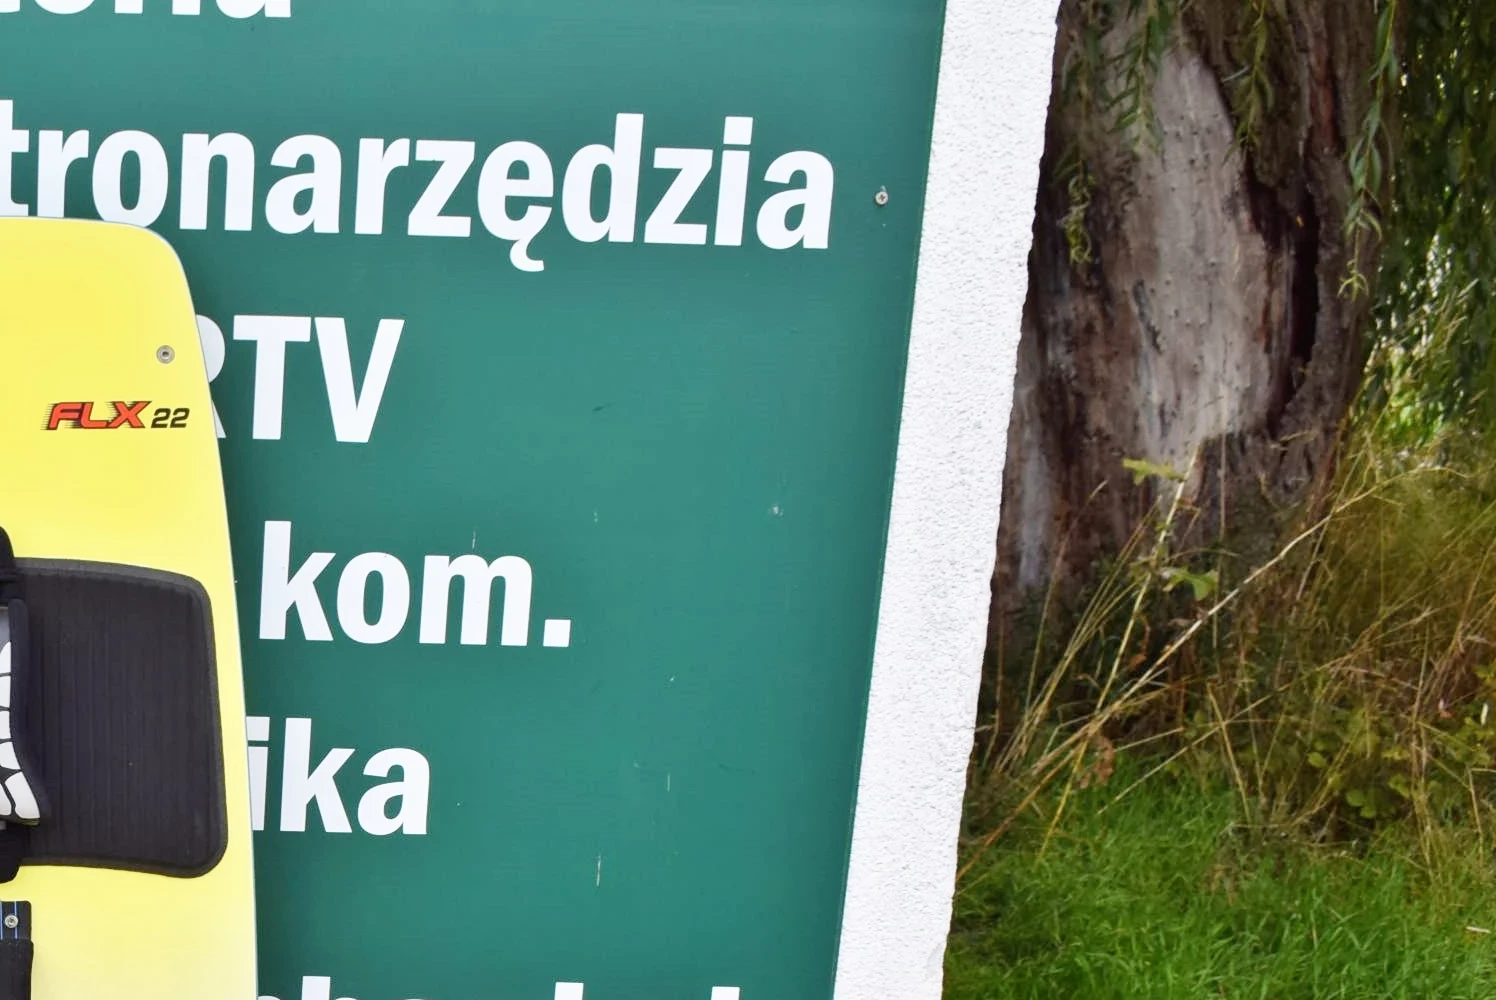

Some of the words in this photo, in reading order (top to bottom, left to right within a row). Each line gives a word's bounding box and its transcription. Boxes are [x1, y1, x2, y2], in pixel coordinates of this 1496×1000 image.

[44, 400, 152, 431] FLX
[150, 407, 190, 429] 22
[259, 520, 572, 648] kom.
[246, 716, 430, 836] ika
